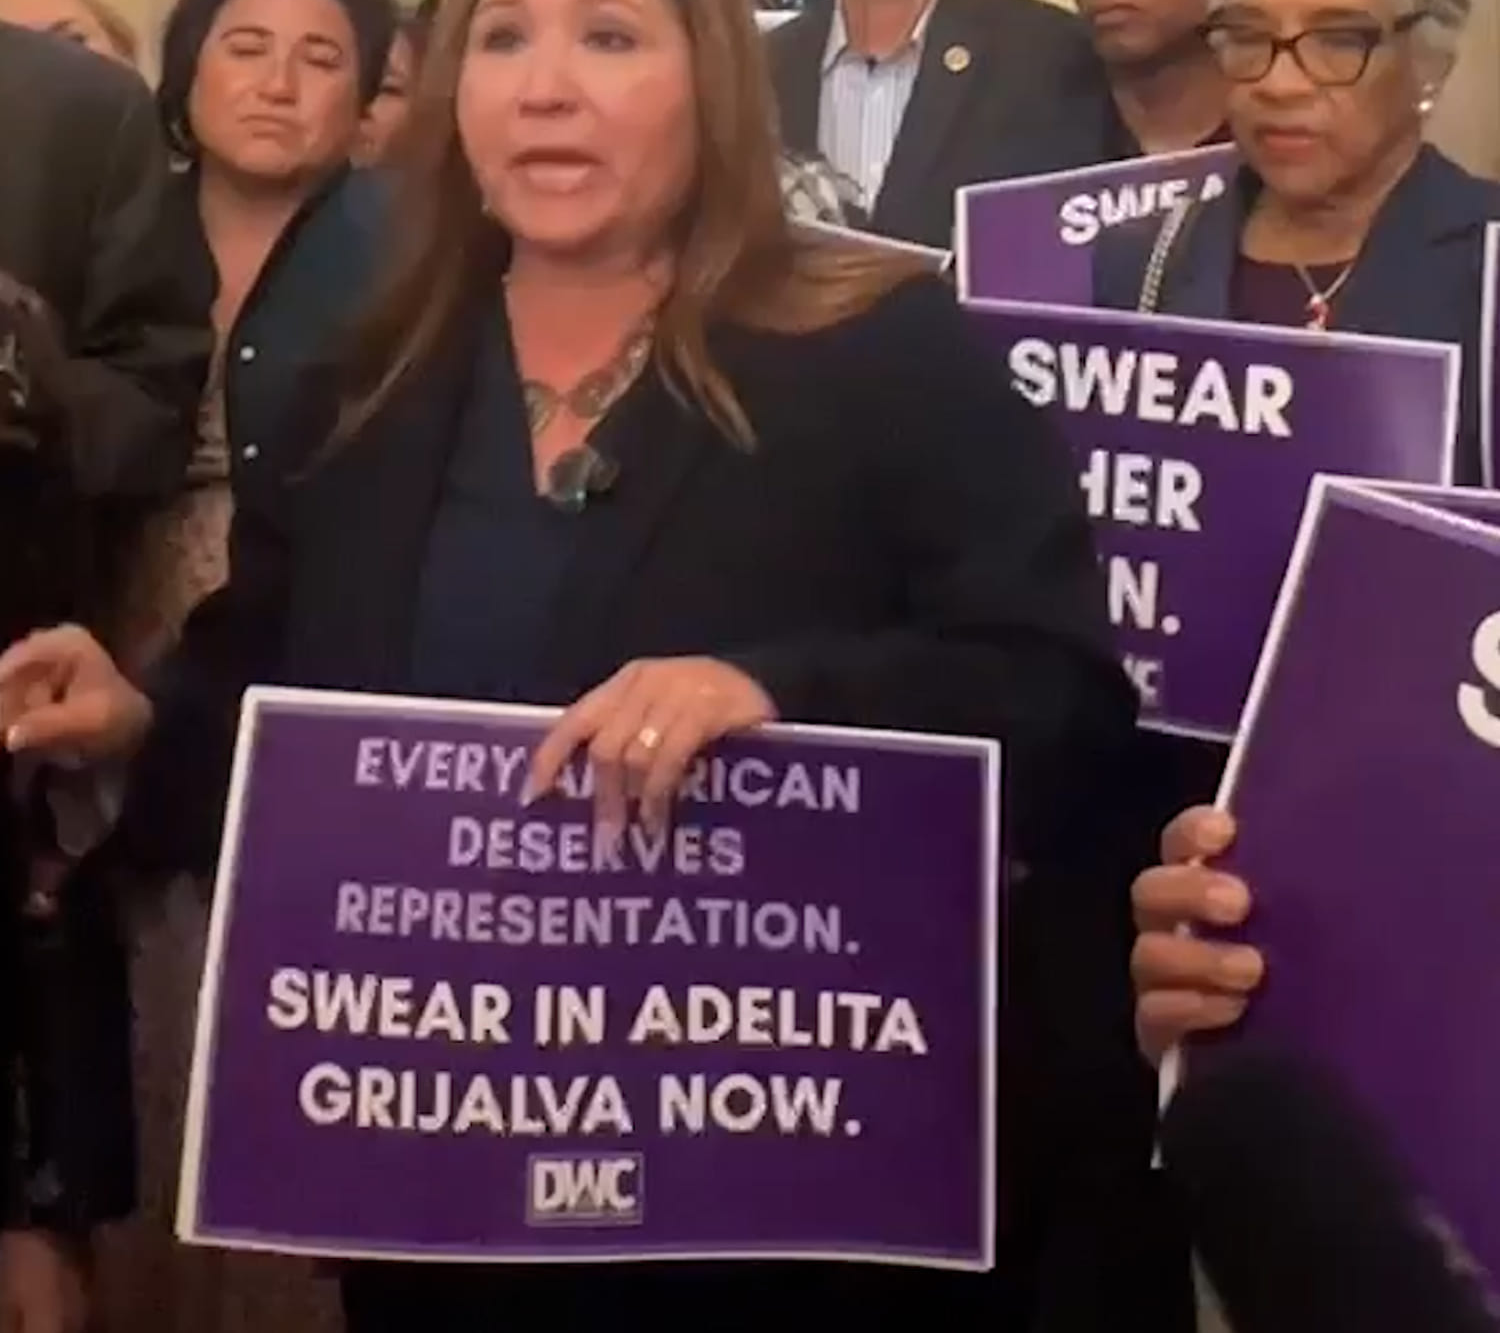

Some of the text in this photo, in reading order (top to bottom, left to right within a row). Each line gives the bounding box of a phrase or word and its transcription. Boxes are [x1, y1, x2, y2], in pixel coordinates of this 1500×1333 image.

[1008, 337, 1293, 438] SWEAR
[1108, 554, 1181, 635] N.
[354, 737, 526, 793] EVERY
[448, 816, 746, 876] DESERVES
[335, 881, 861, 955] REPRESENTATION.
[267, 968, 928, 1055] SWEAR IN ADELITA
[299, 1062, 862, 1138] GRIJALVA NOW.
[531, 1156, 638, 1213] DWC
